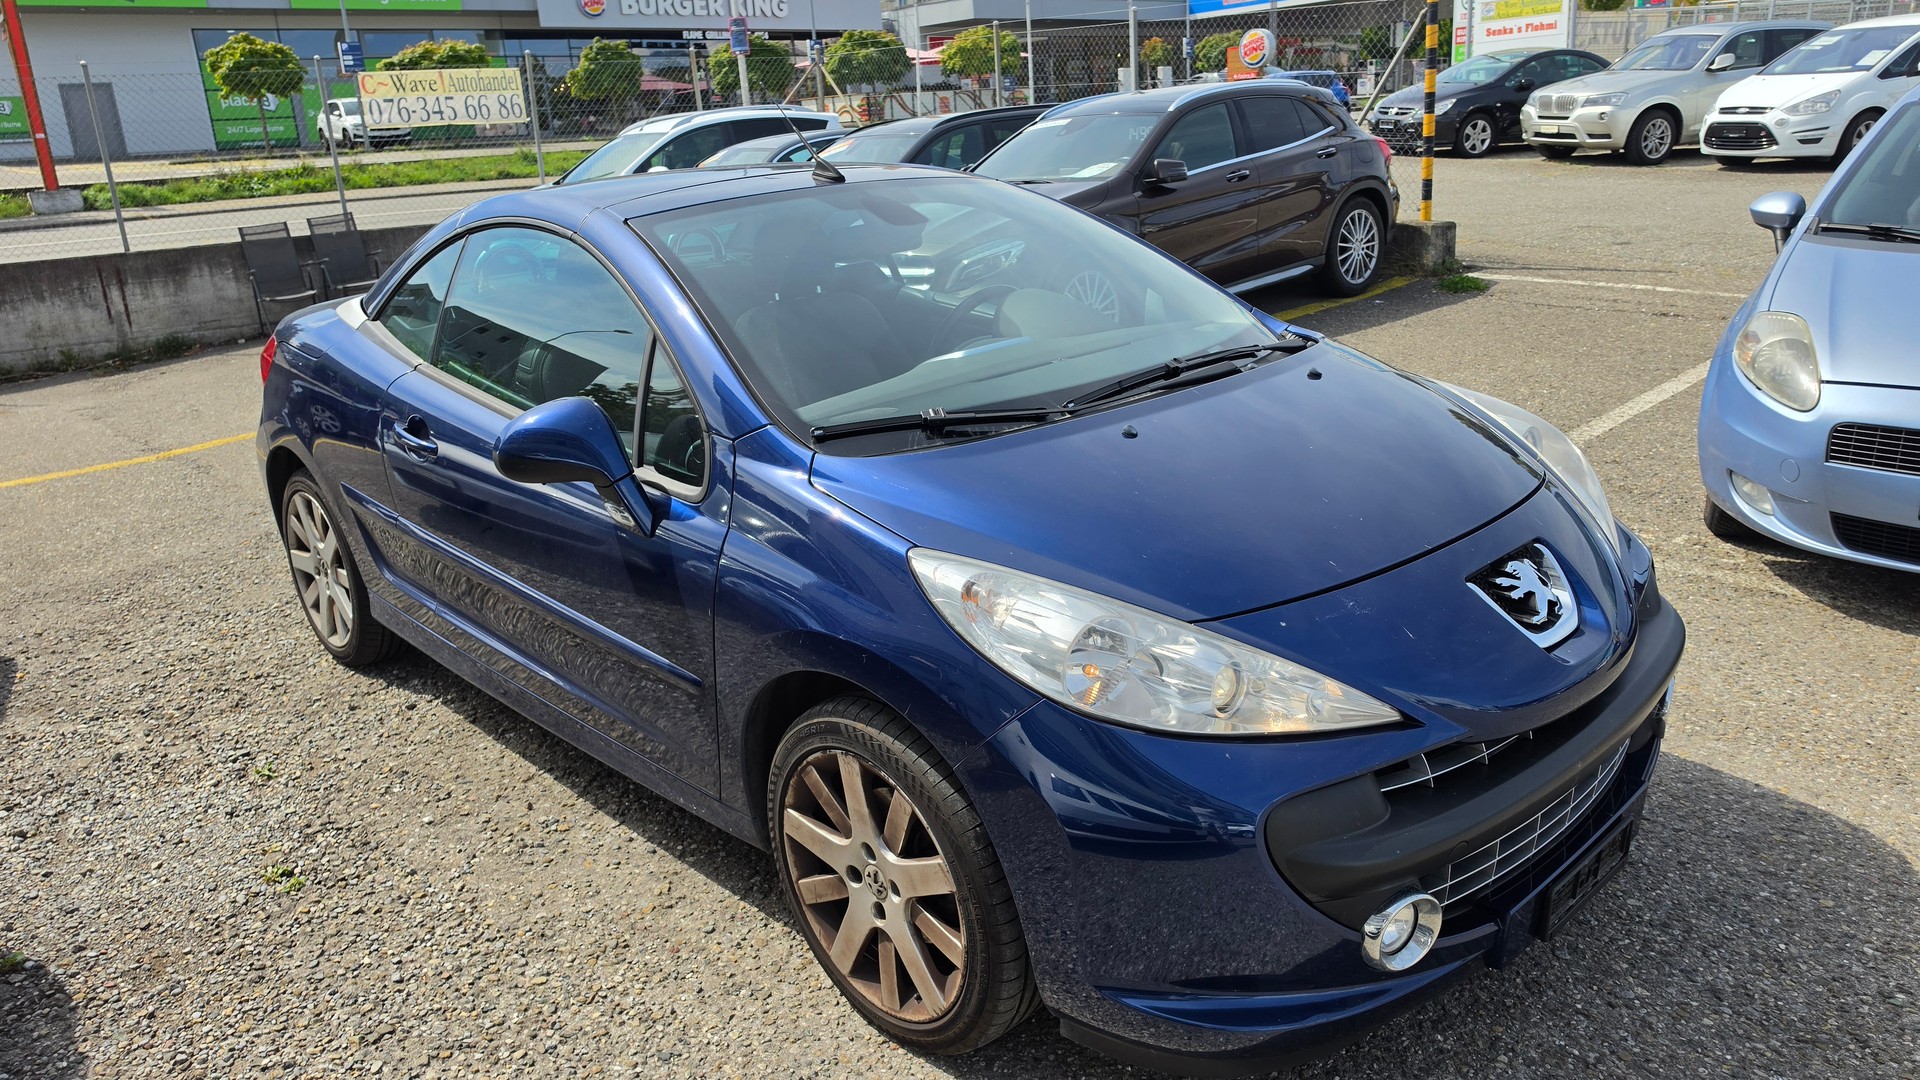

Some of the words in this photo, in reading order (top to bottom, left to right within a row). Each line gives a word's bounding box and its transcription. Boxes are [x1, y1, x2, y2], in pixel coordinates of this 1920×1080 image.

[621, 0, 725, 17] BURGER
[730, 0, 790, 18] KING
[1525, 20, 1557, 32] Flohmi
[1243, 42, 1265, 58] KING
[448, 70, 519, 93] Autohandel
[369, 96, 458, 125] 076-345
[464, 95, 491, 120] 66
[497, 94, 523, 120] 86
